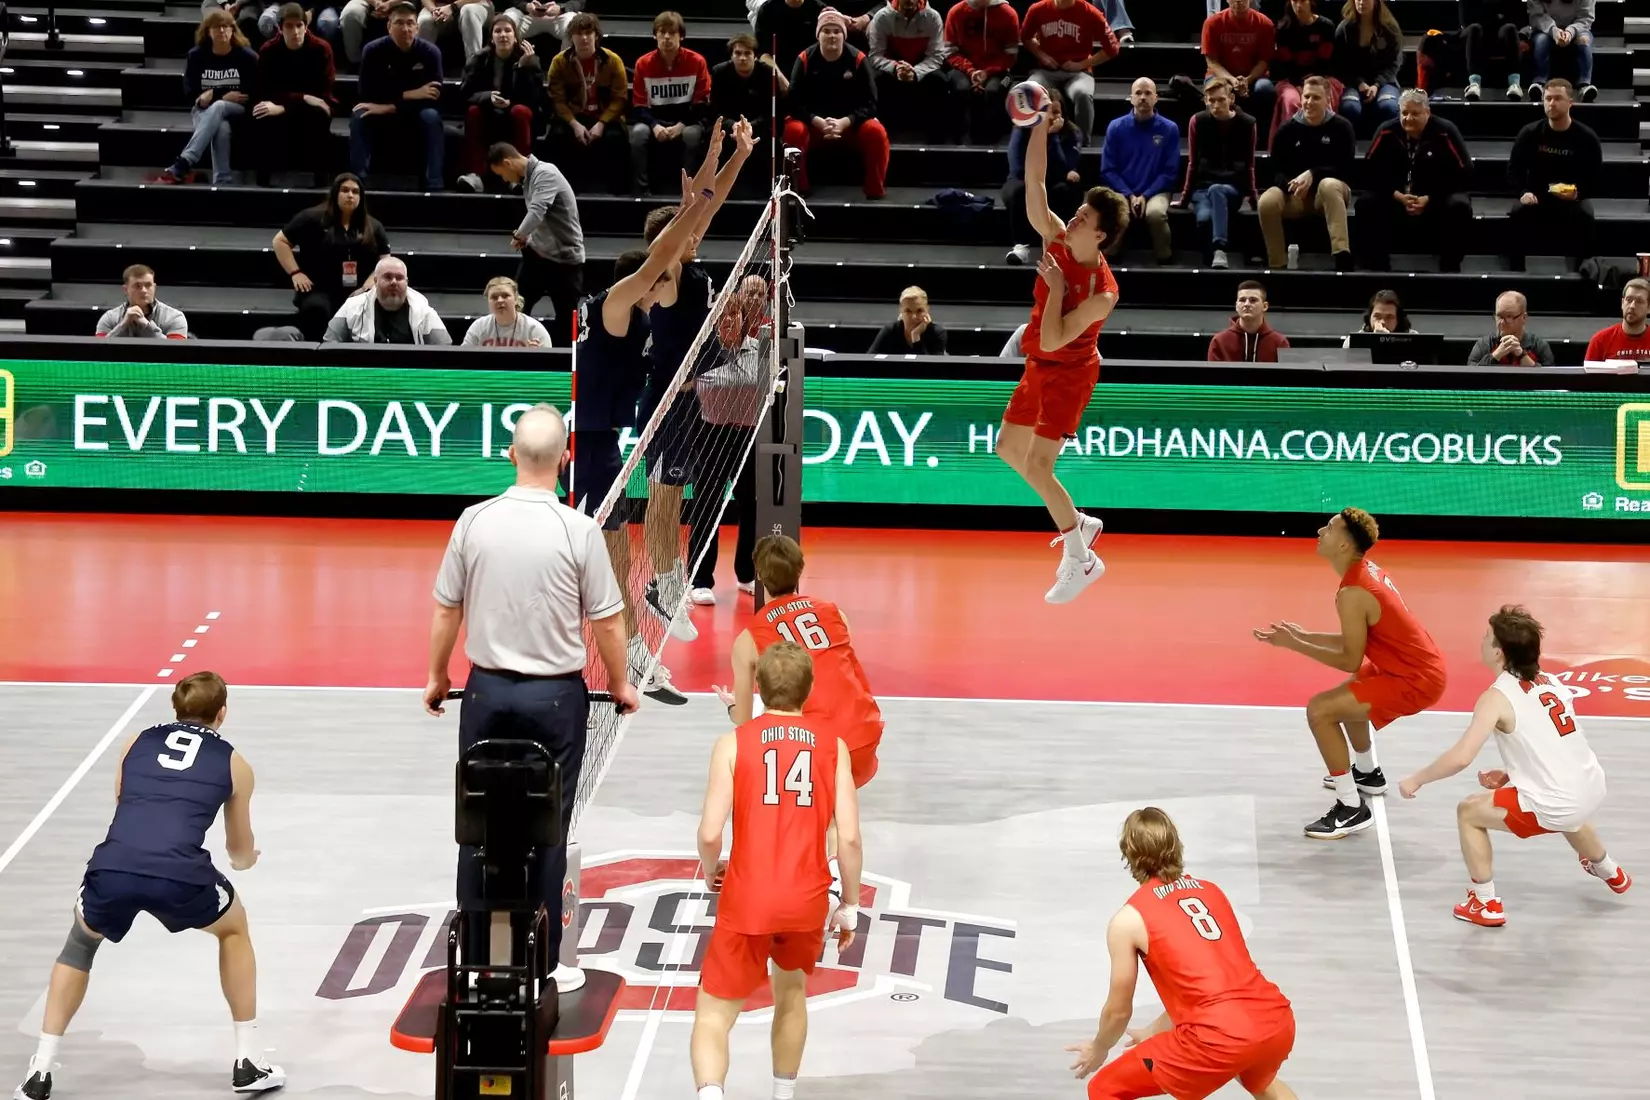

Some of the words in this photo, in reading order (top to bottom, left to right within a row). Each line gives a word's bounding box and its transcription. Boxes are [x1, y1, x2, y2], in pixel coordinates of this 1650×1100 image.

[1057, 19, 1081, 43] STATE
[201, 68, 240, 80] JUNIATA
[651, 83, 690, 98] PUMA
[74, 394, 295, 455] EVERY
[317, 400, 460, 457] DAY
[803, 409, 939, 468] DAY.
[968, 423, 1563, 466] HARDHANNA.COM/GOBUCKS
[766, 606, 786, 623] OHIO
[786, 600, 815, 613] STATE
[775, 612, 831, 650] 16
[1538, 691, 1577, 737] 2
[156, 729, 204, 771] 9
[761, 725, 785, 744] OHIO
[787, 725, 816, 748] STATE
[762, 748, 814, 807] 14
[1177, 896, 1223, 941] 8
